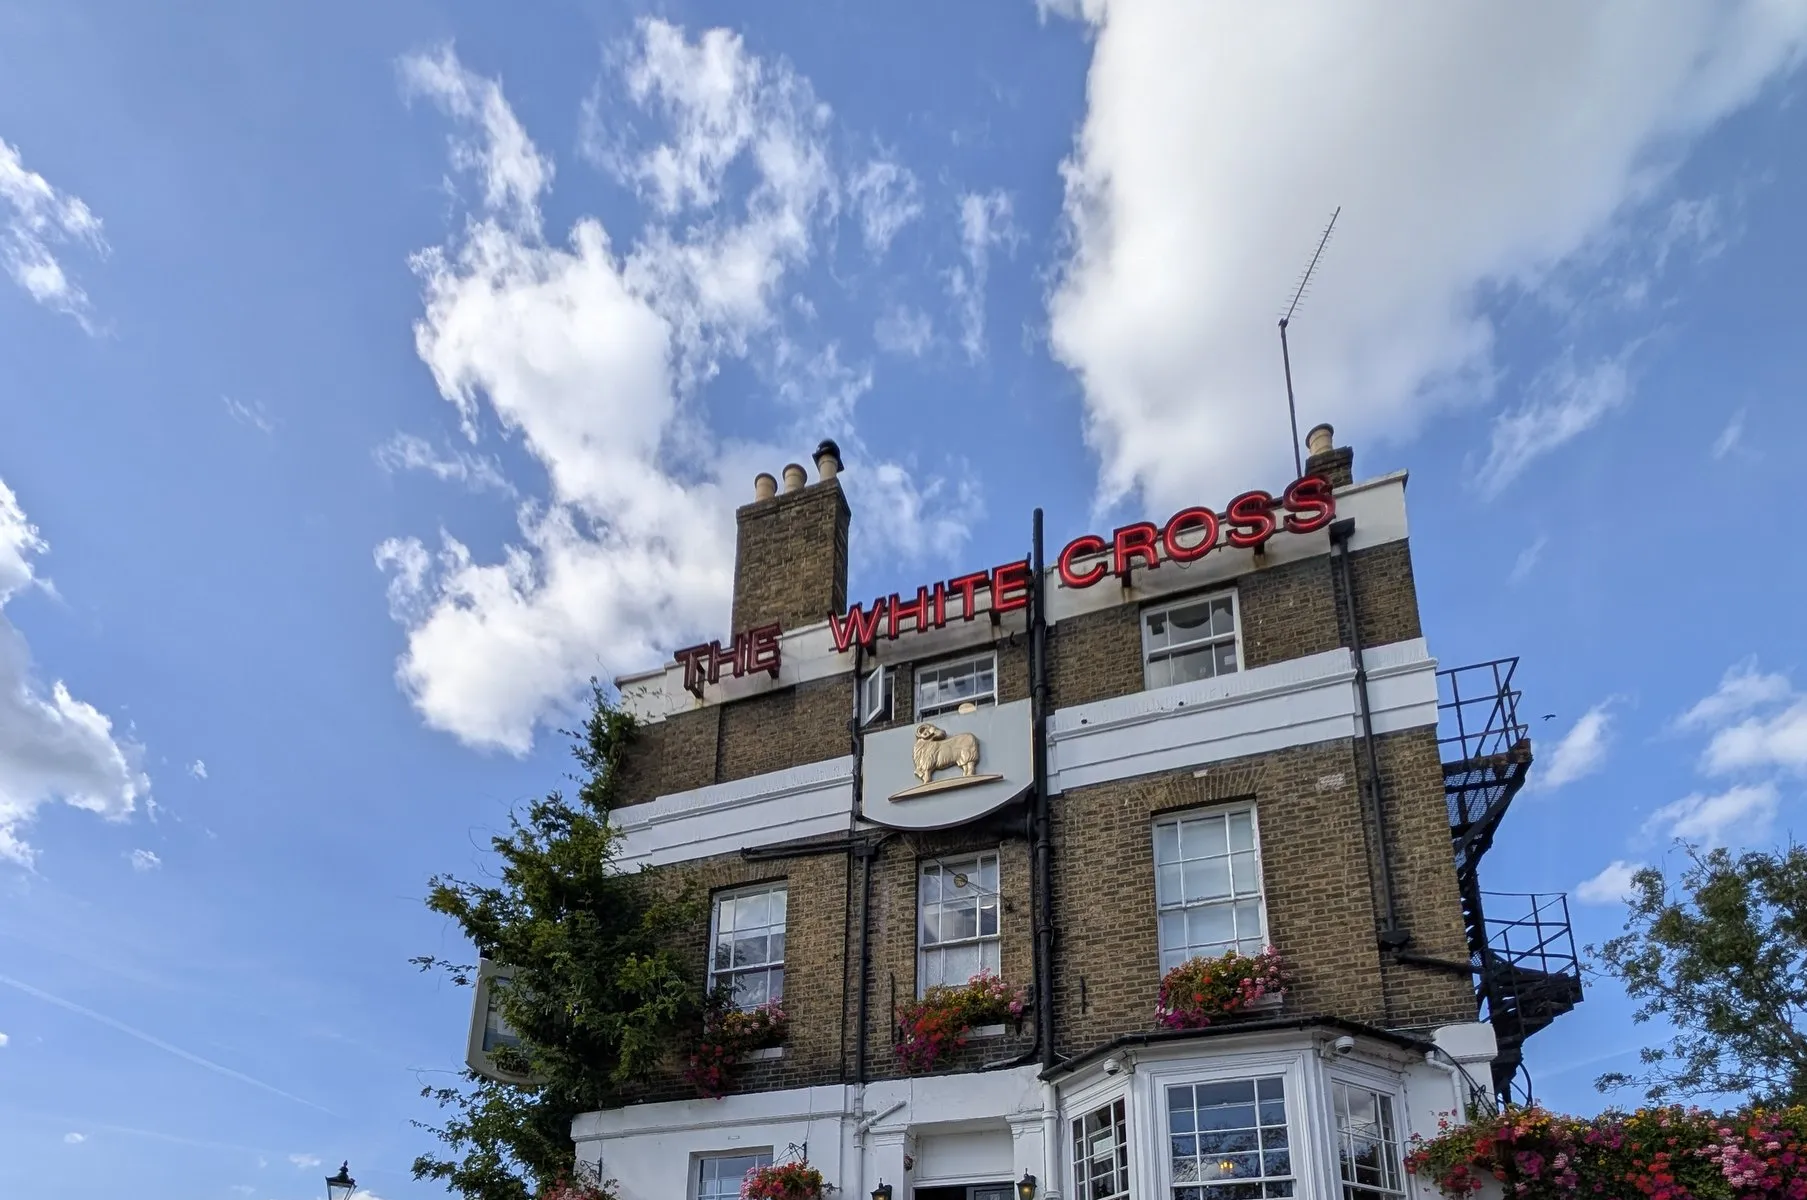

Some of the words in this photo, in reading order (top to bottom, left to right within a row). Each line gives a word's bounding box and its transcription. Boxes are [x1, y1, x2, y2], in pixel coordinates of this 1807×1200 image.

[674, 622, 782, 691] THE
[828, 560, 1029, 653] WHITE
[1058, 474, 1336, 589] CROSS
